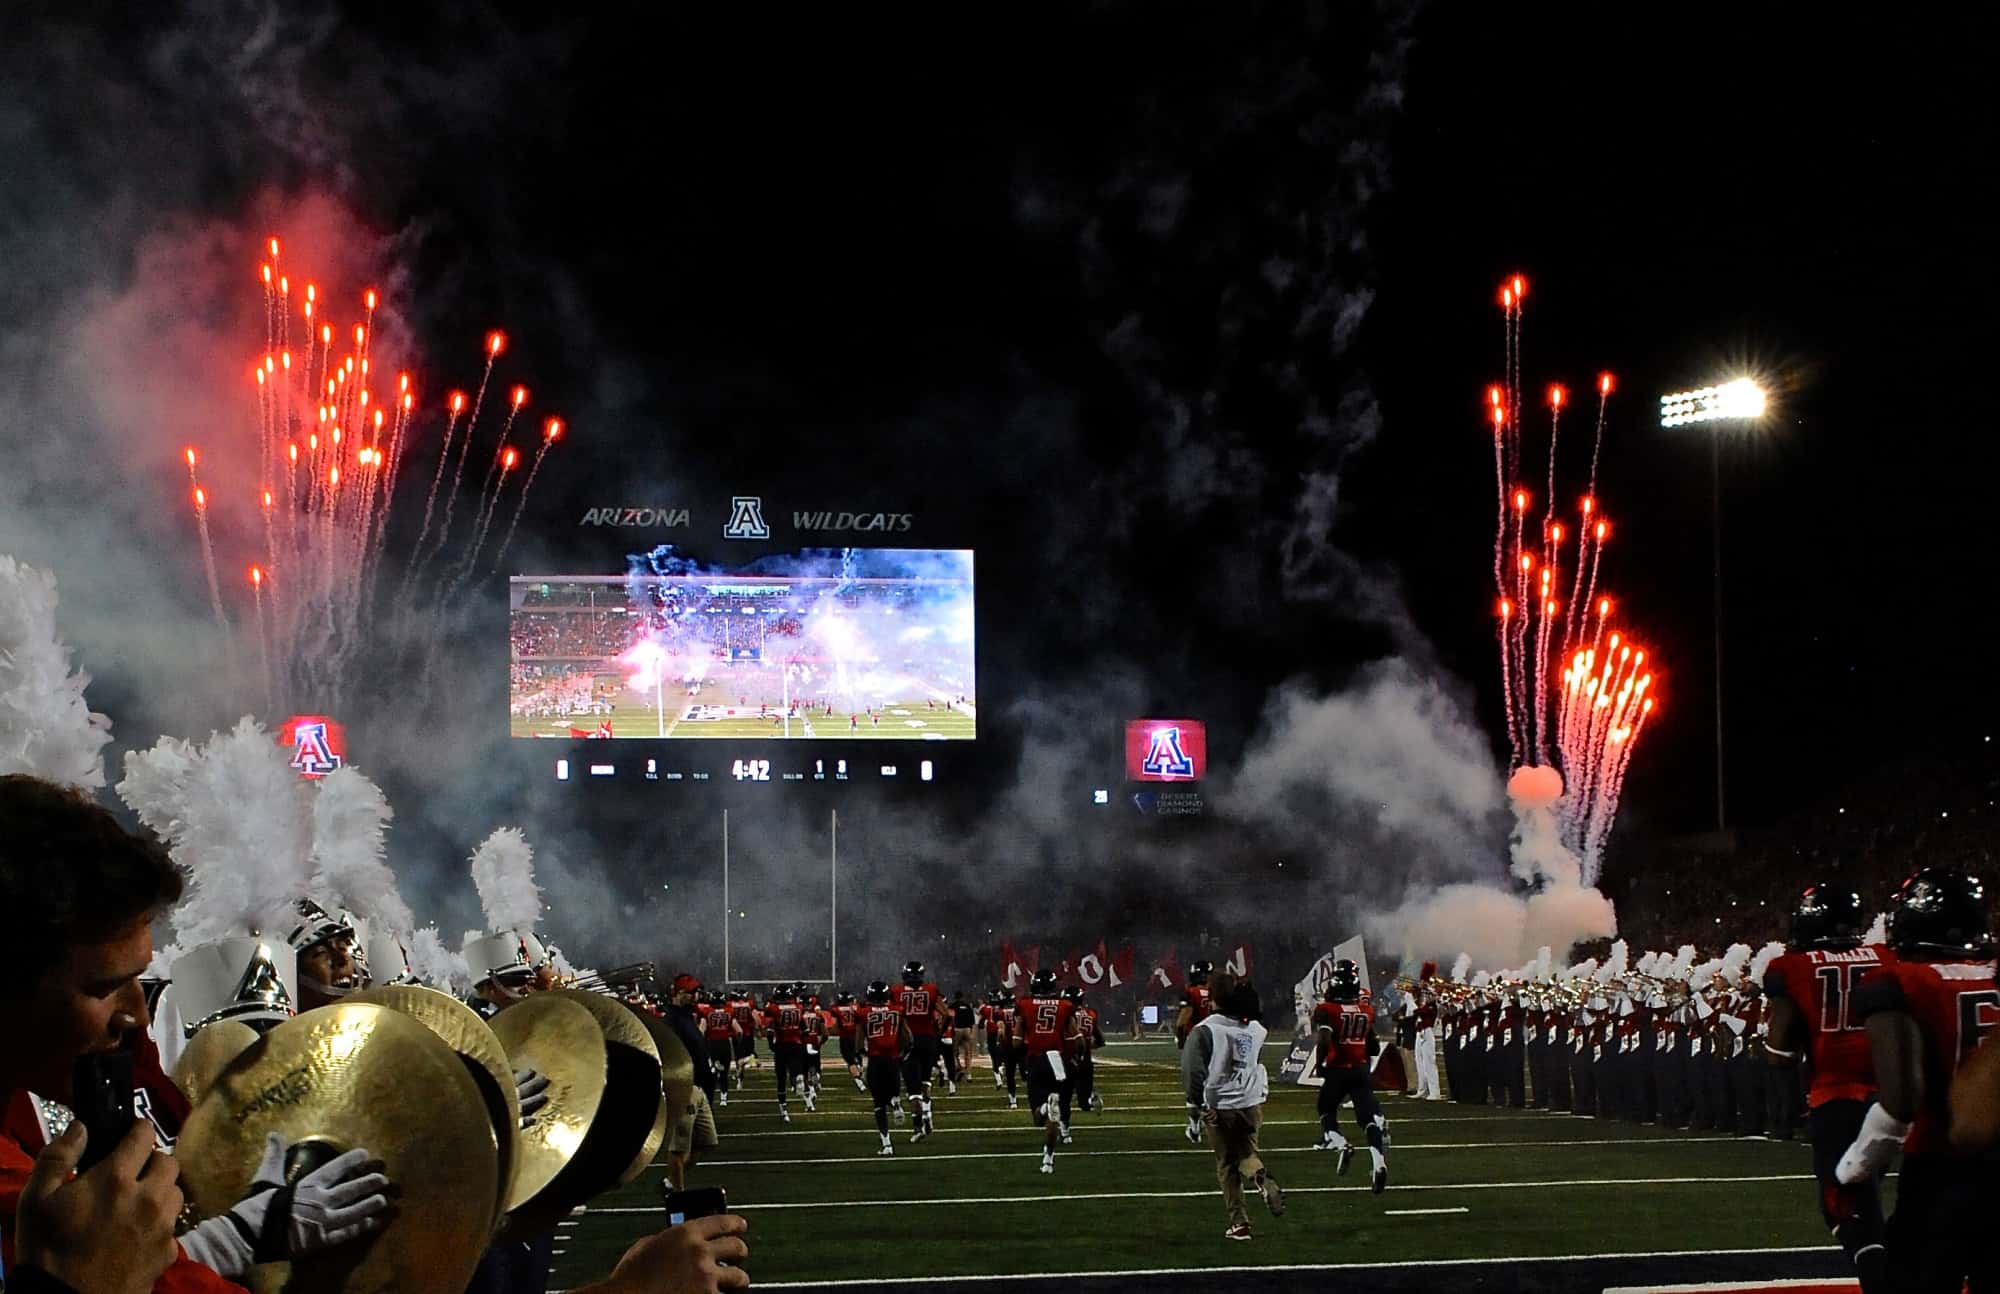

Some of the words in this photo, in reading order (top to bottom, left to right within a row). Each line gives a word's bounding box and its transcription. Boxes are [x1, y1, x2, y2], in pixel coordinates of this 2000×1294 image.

[579, 507, 691, 528] ARIZONA
[723, 496, 770, 539] A
[793, 511, 913, 533] WILDCATS
[1143, 727, 1194, 777] A
[732, 760, 770, 781] 4:42
[1156, 800, 1204, 808] DIAMOND
[1822, 946, 1880, 963] MILLER
[899, 991, 931, 1016] 73
[866, 1010, 900, 1038] 27
[1035, 1005, 1058, 1034] 5
[1339, 1012, 1369, 1046] 10
